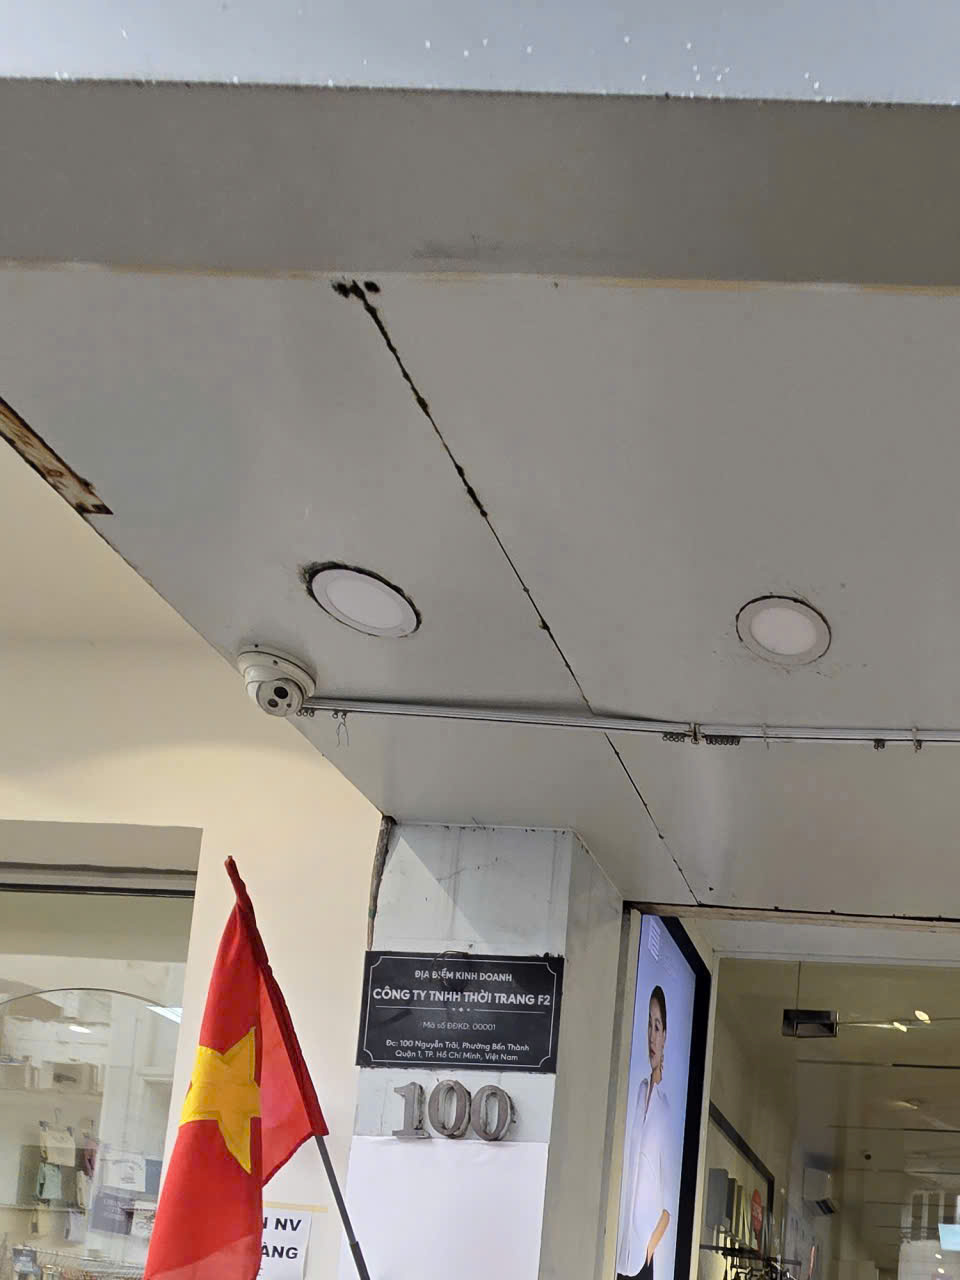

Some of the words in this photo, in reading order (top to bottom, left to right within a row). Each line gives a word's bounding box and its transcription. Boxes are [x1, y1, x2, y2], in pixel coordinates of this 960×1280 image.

[456, 971, 478, 981] KINH
[479, 972, 513, 982] DOANH
[372, 985, 411, 1000] CÔNG
[412, 989, 427, 1000] TY
[429, 990, 461, 1002] TNHH
[463, 989, 492, 1004] THỜI
[494, 993, 535, 1005] TRANG
[537, 995, 551, 1006] F2
[400, 1039, 414, 1048] 100
[500, 1053, 519, 1062] Nam
[392, 1079, 513, 1141] 100
[274, 1217, 302, 1232] NV
[260, 1241, 299, 1260] ÀNG
